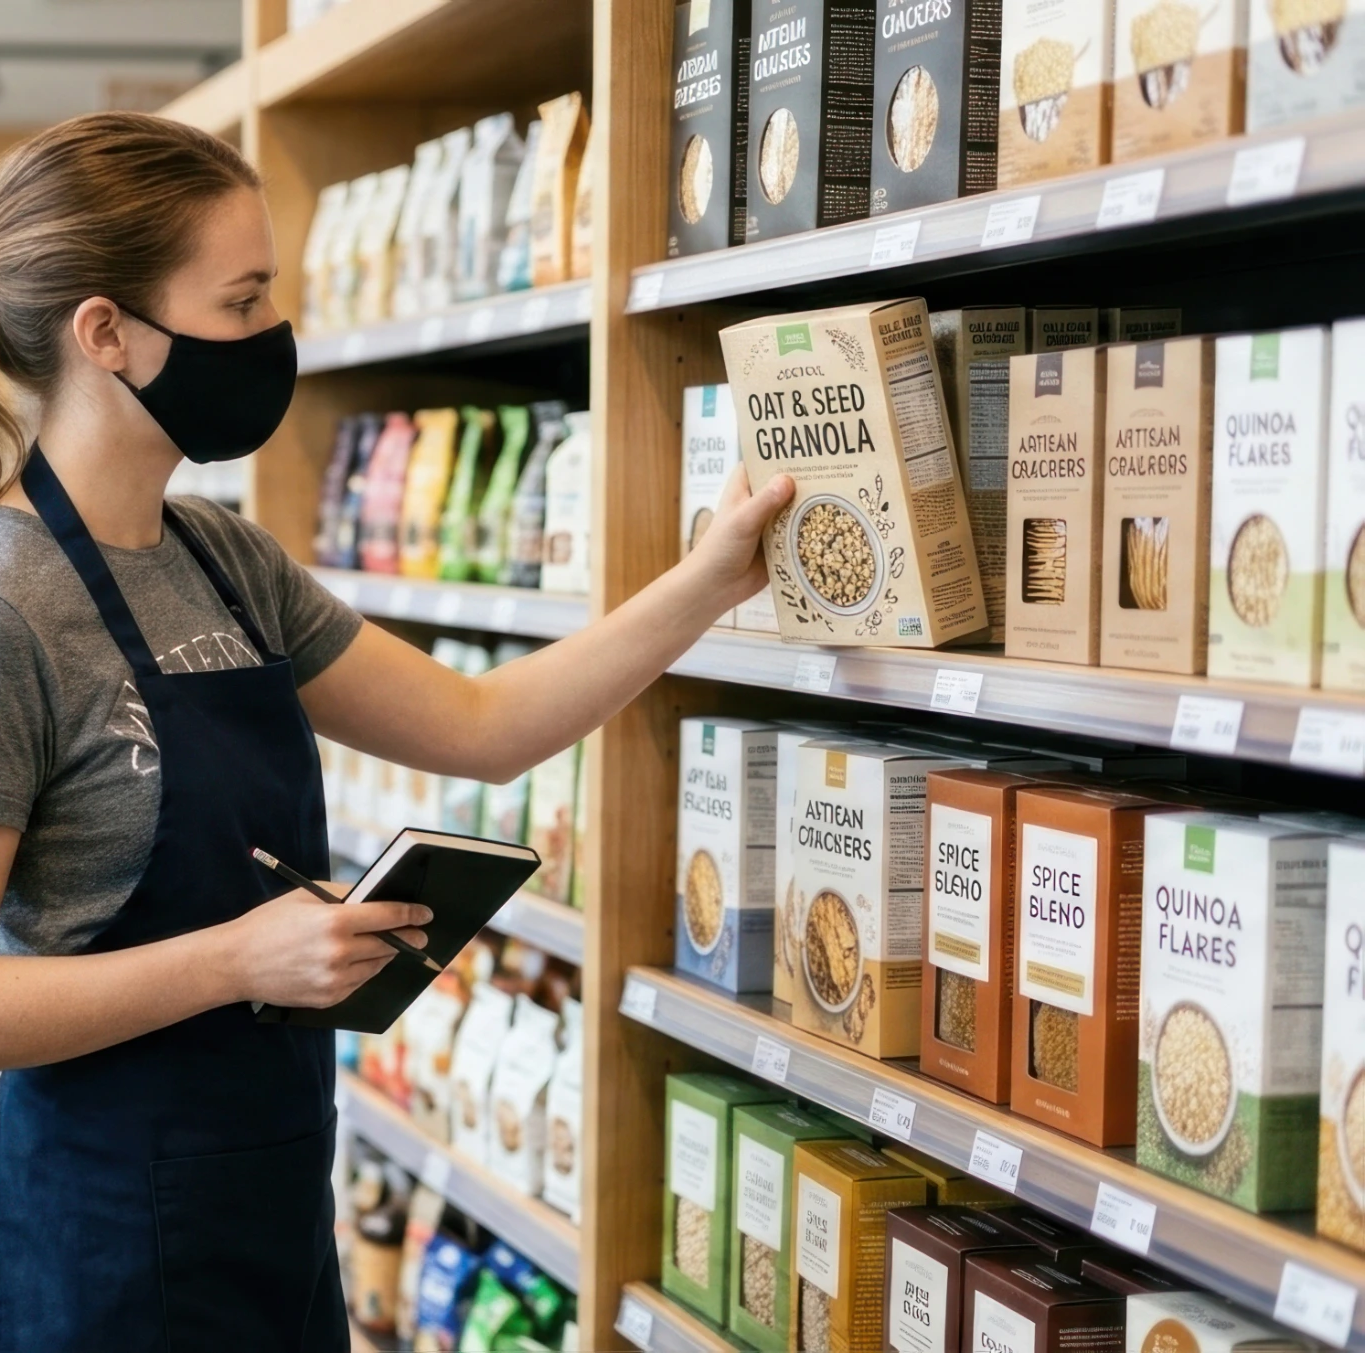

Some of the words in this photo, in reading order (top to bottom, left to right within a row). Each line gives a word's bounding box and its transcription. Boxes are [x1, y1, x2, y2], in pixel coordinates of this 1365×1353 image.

[748, 391, 785, 422] OAT
[792, 390, 809, 418] &
[811, 383, 866, 416] SEED
[755, 418, 876, 461] GRANOLA
[1226, 411, 1297, 439] QUINOA
[1228, 442, 1292, 468] FLARES
[1031, 864, 1081, 897] SPICE
[1156, 885, 1243, 931] QUINOA
[1158, 923, 1237, 968] FLARES
